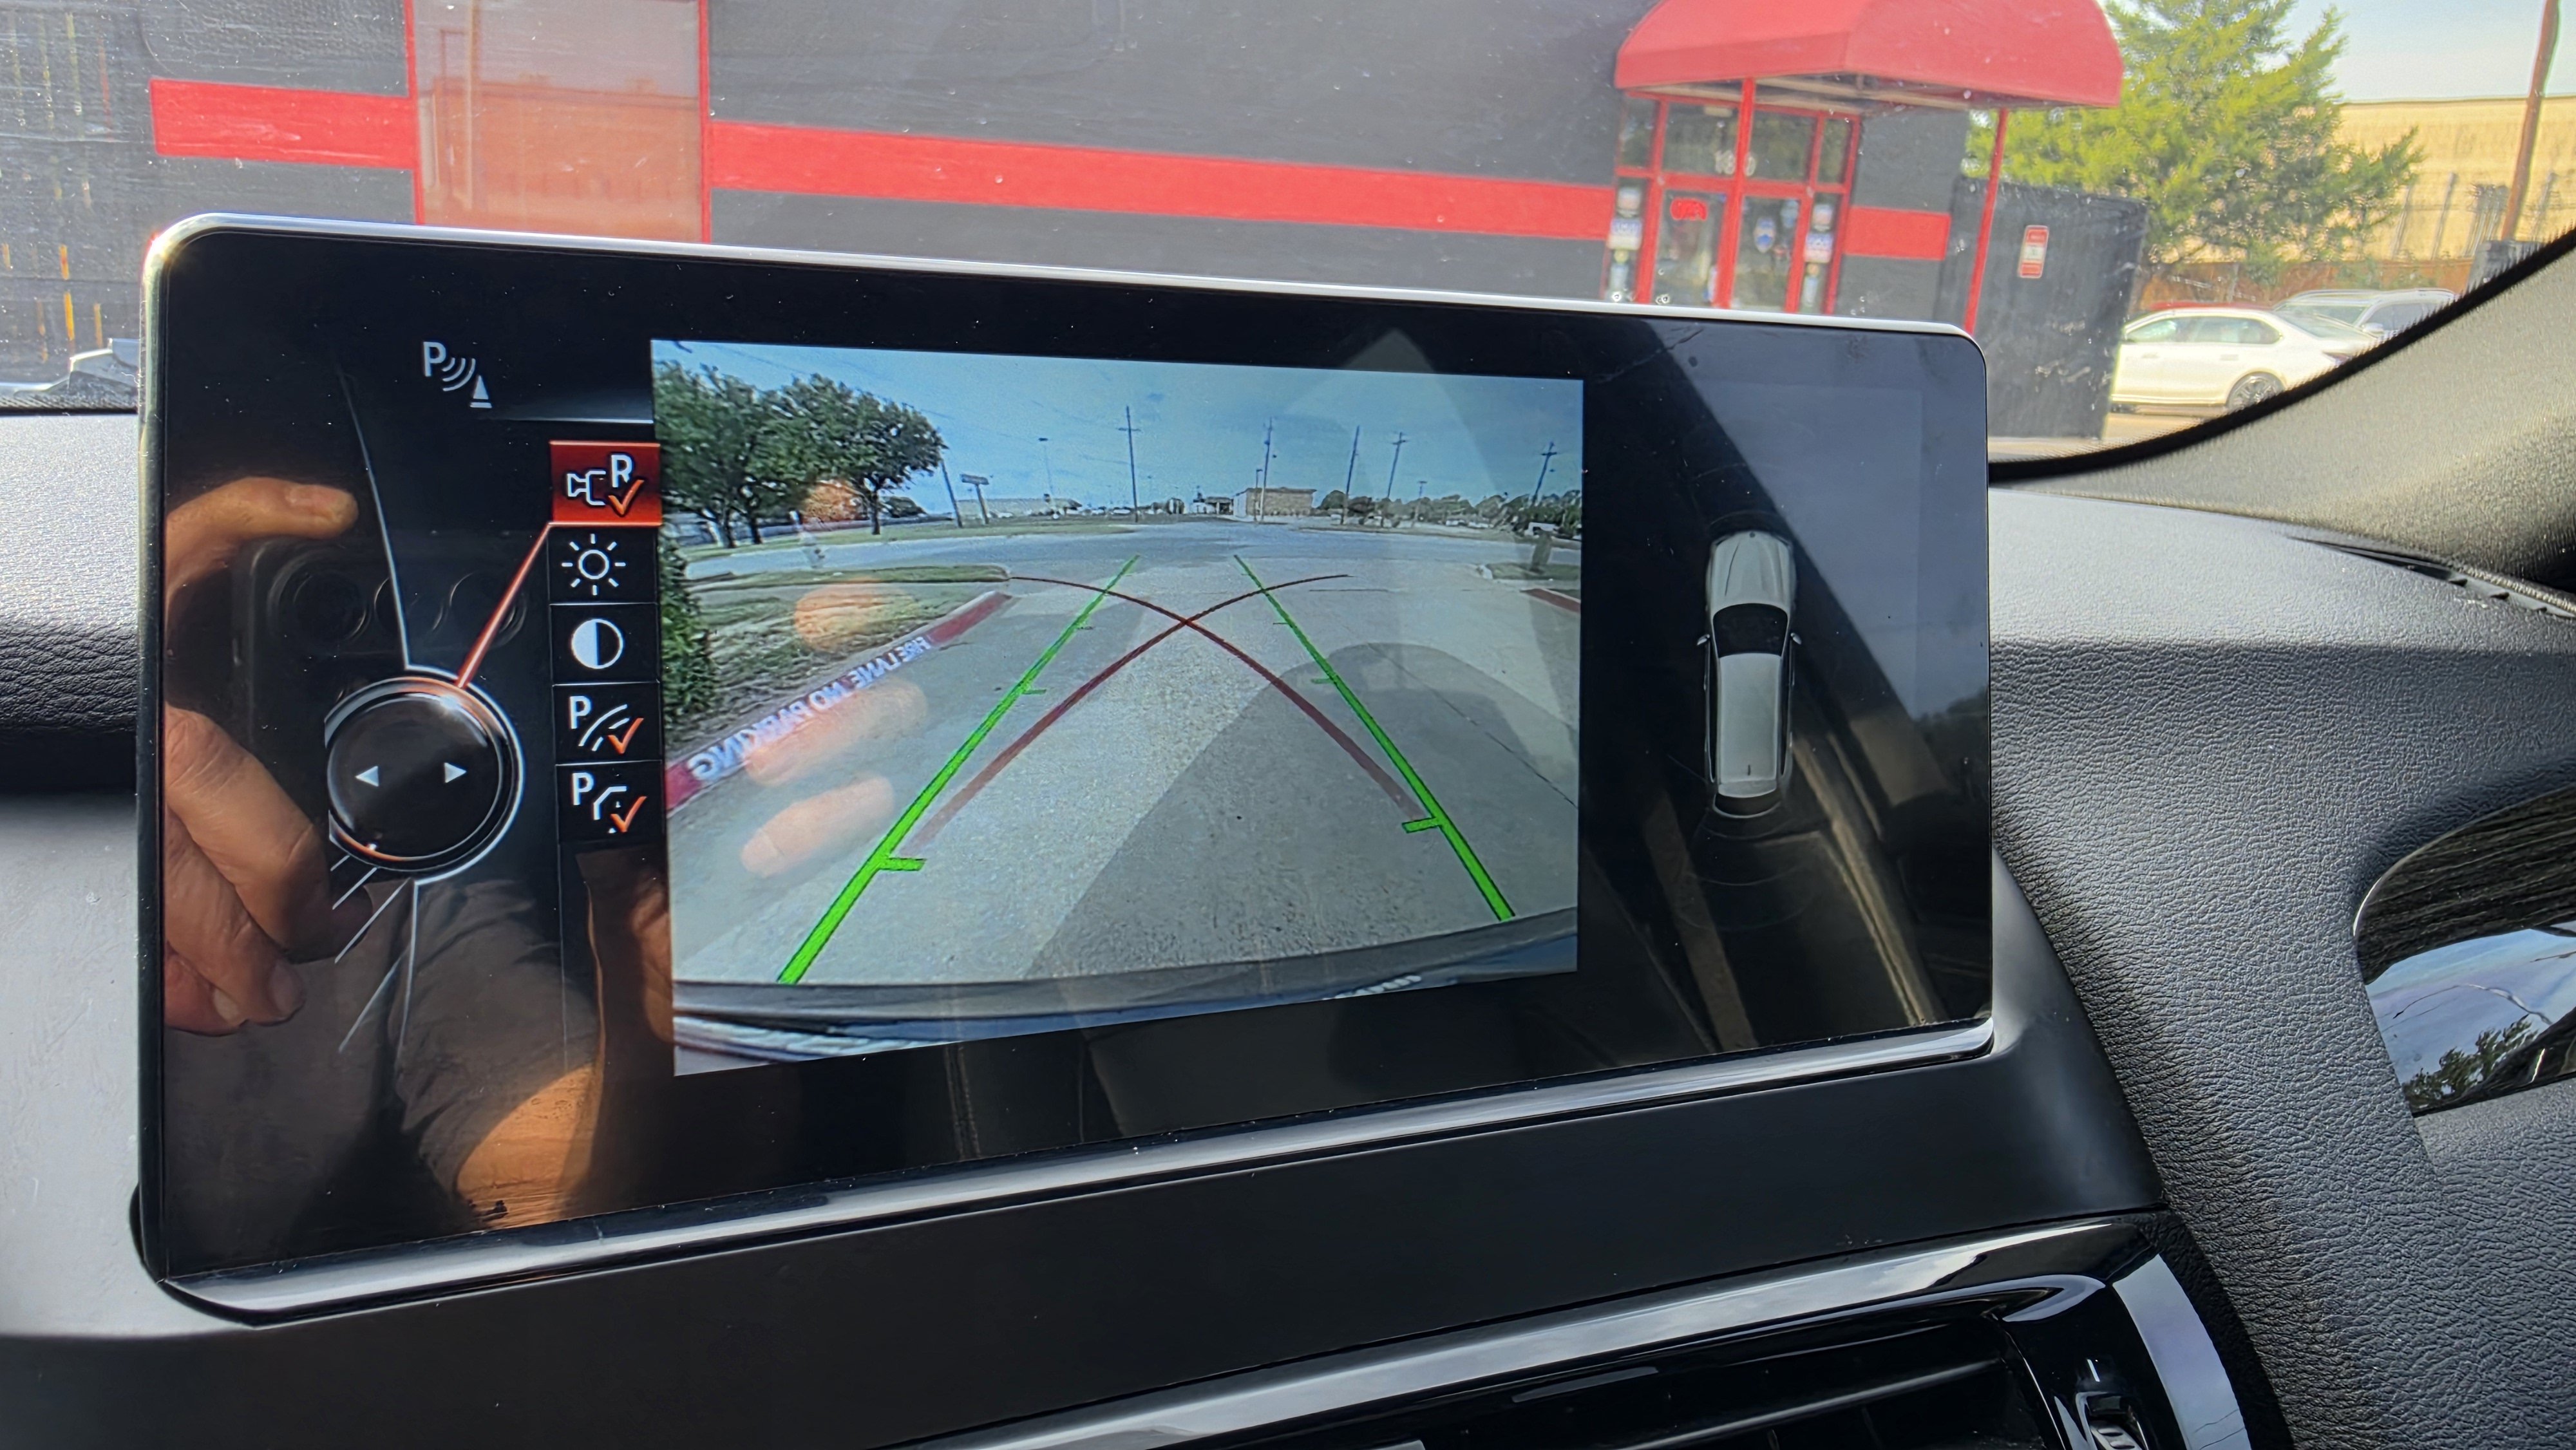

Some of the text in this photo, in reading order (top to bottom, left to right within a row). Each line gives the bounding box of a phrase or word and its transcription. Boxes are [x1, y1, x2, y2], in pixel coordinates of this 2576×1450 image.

[423, 341, 446, 377] P
[611, 454, 632, 487] R
[569, 695, 591, 730] P
[572, 772, 594, 805] P
